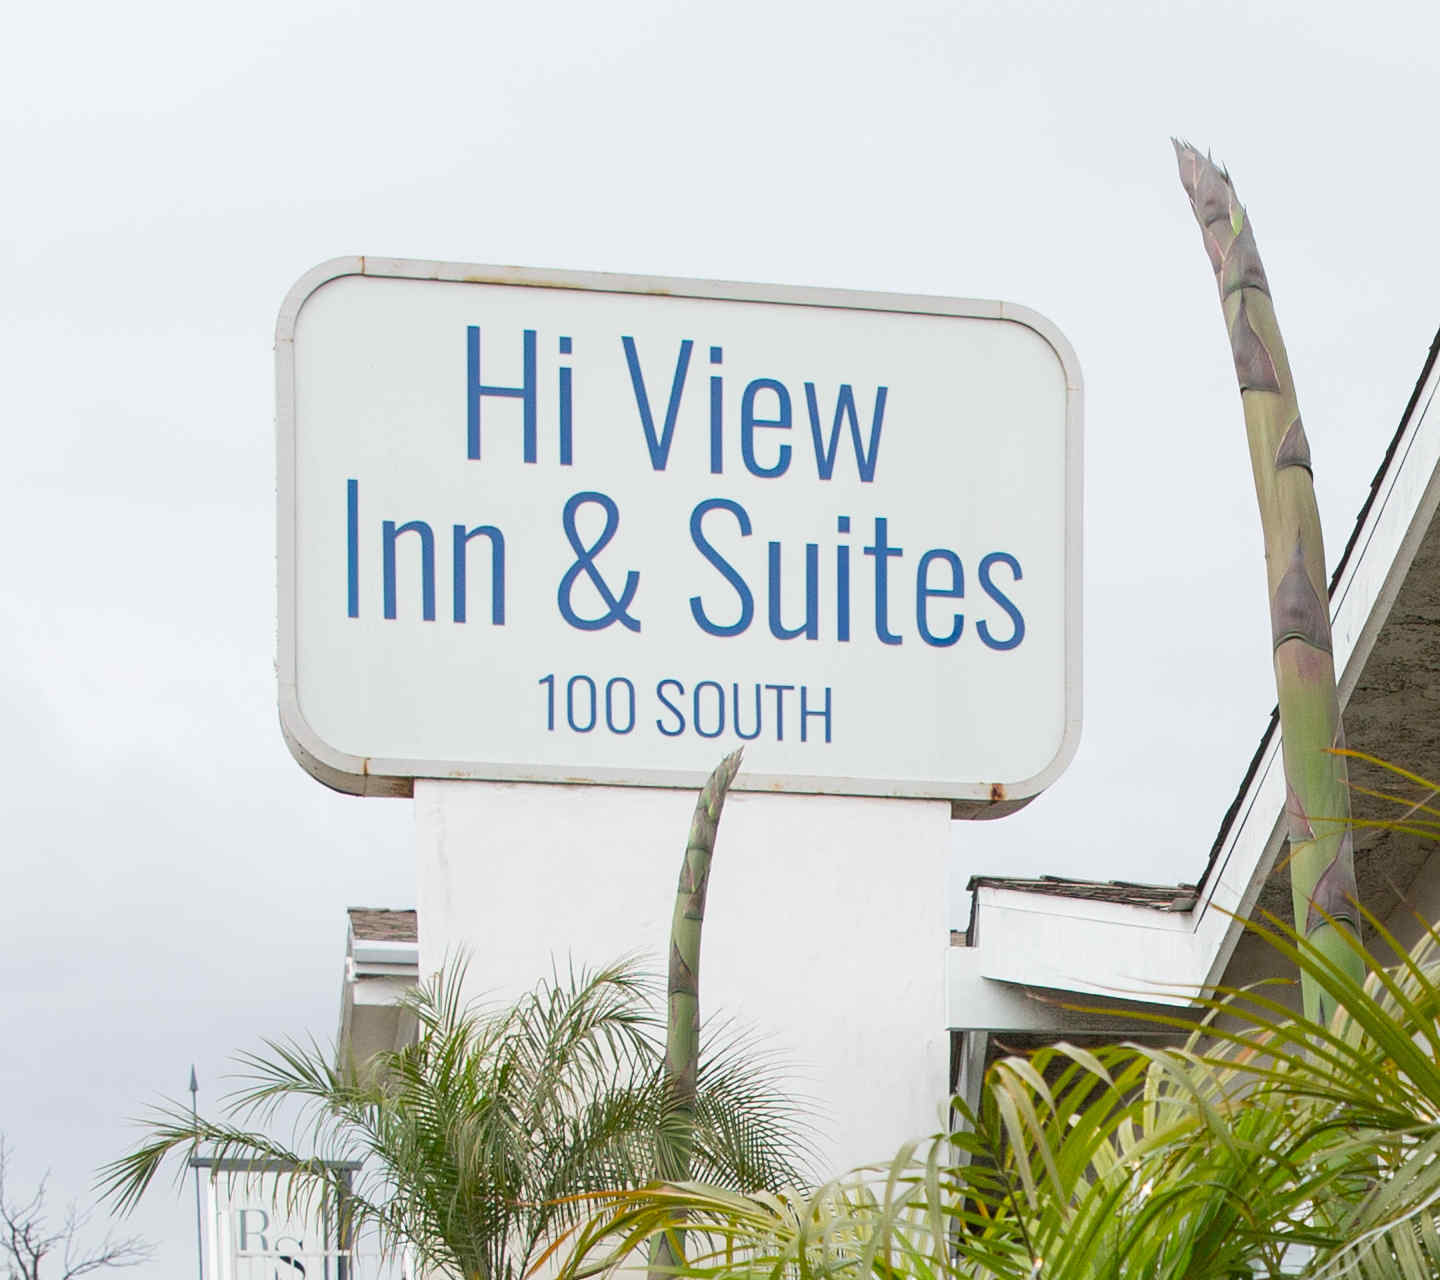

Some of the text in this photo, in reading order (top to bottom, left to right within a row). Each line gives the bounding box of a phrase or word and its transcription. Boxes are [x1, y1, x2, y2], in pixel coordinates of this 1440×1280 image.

[466, 325, 890, 484] Hi View
[346, 478, 1027, 652] Inn & Suites
[538, 673, 833, 744] 100 SOUTH
